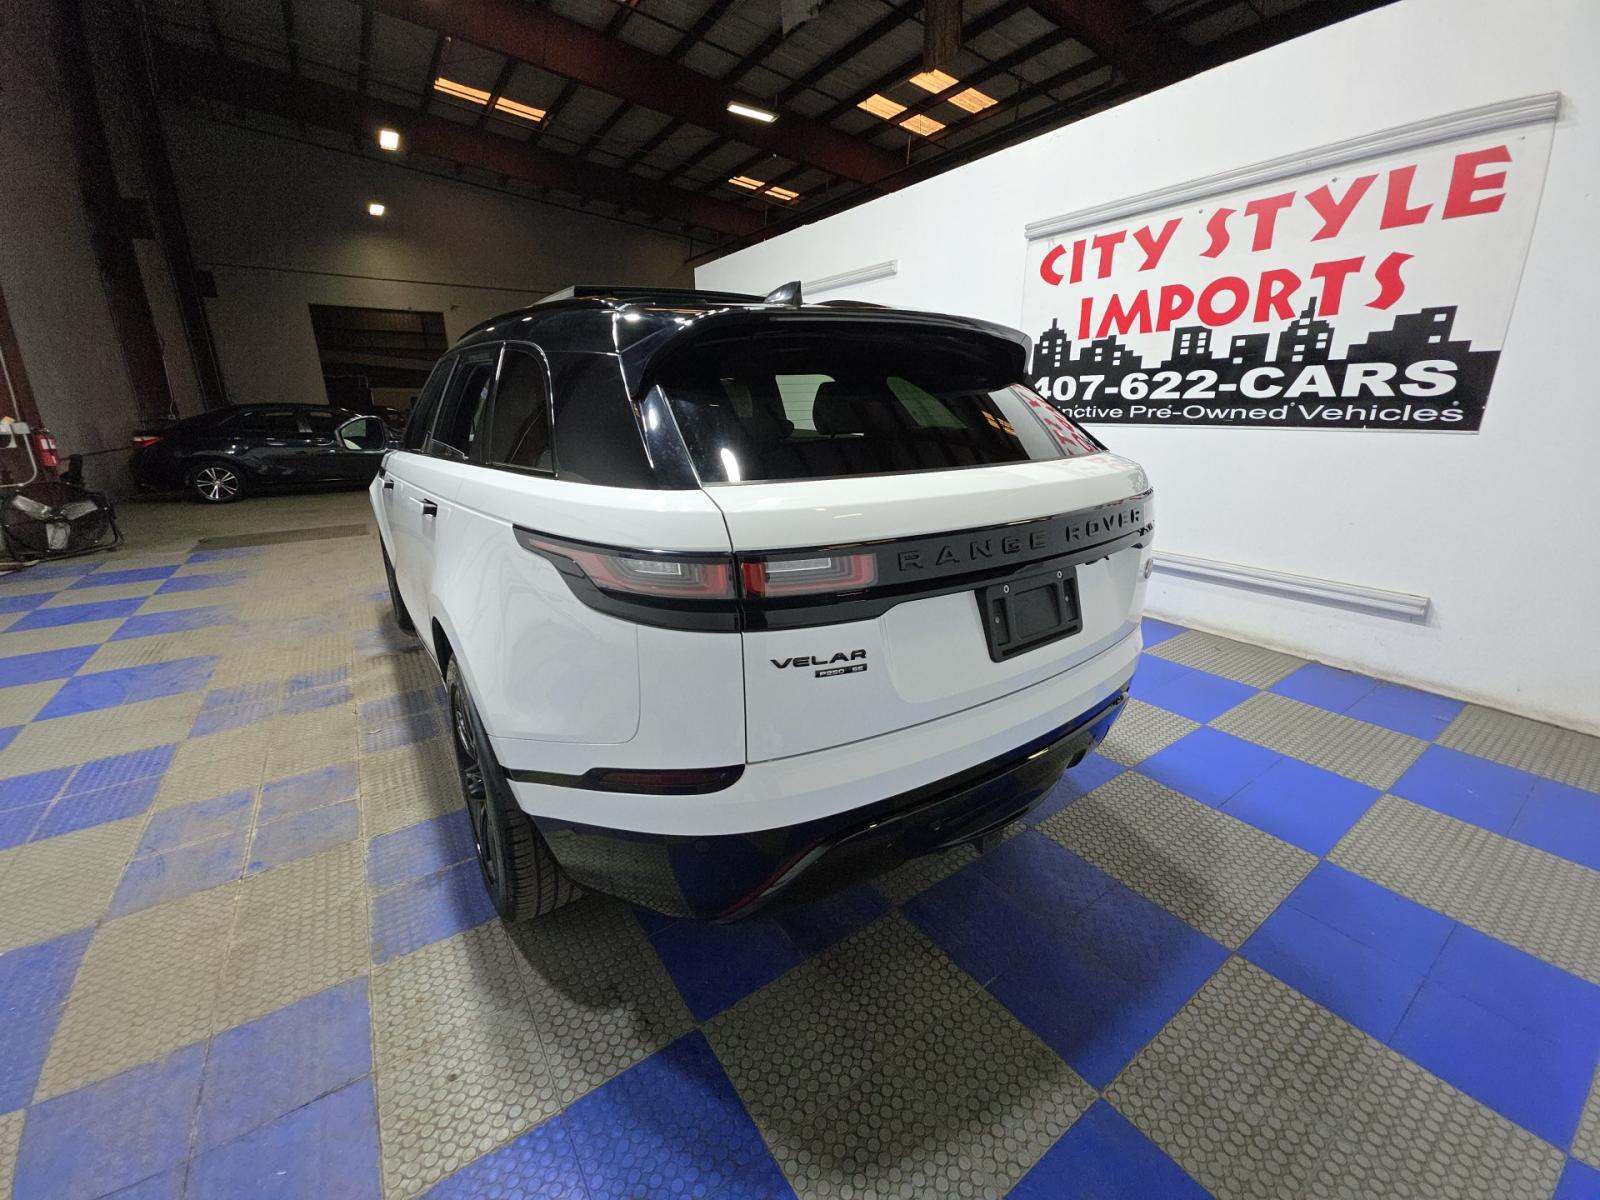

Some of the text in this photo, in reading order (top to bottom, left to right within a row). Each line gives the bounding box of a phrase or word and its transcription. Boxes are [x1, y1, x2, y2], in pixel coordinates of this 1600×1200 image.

[1039, 145, 1512, 287] CITY STYLE
[1077, 252, 1415, 340] IMPORTS
[1035, 360, 1458, 401] 407-622-CARS
[1129, 405, 1287, 421] Pre-Owned
[1299, 404, 1464, 422] Vehicles
[897, 509, 1140, 571] RANGE ROVER
[770, 649, 867, 669] VELAR
